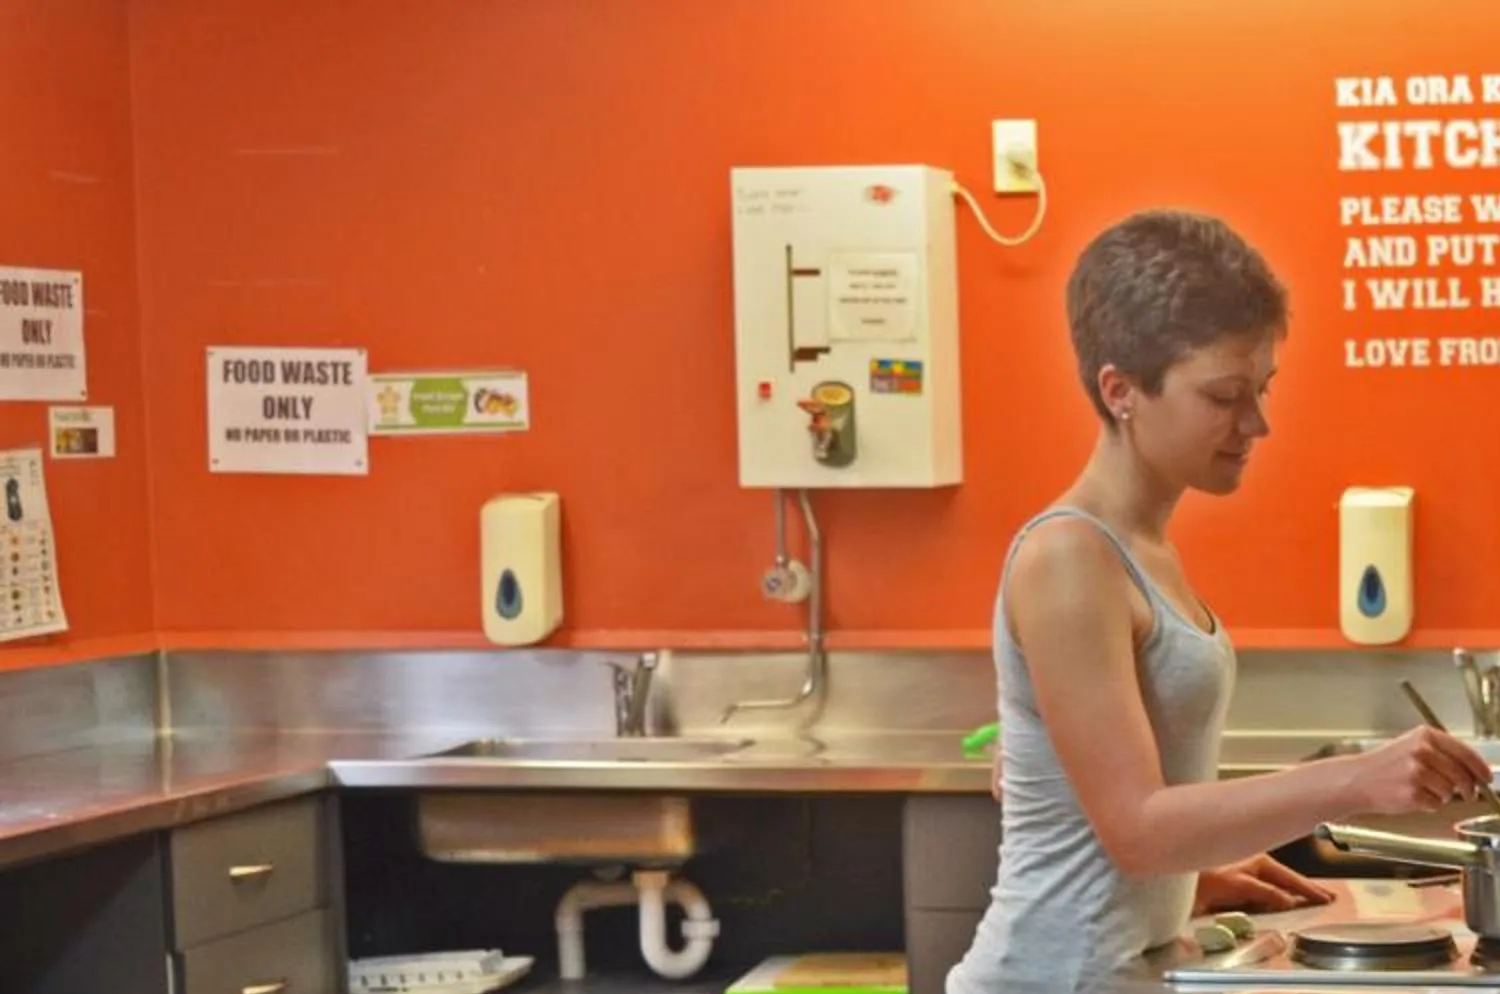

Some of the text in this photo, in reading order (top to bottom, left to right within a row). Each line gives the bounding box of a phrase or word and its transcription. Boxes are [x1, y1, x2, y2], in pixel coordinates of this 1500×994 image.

[1335, 78, 1395, 106] KIA
[1406, 76, 1473, 104] ORA
[1340, 195, 1460, 225] PLEASE
[1345, 237, 1416, 267] AND
[1427, 235, 1500, 265] PUT
[31, 282, 73, 309] WASTE
[1343, 281, 1356, 310] I
[1368, 279, 1469, 309] WILL
[21, 319, 52, 345] ONLY
[1346, 339, 1429, 367] LOVE
[223, 360, 352, 385] FOOD WASTE
[263, 396, 313, 419] ONLY
[226, 429, 351, 443] NO PAPER OR PLASTIC
